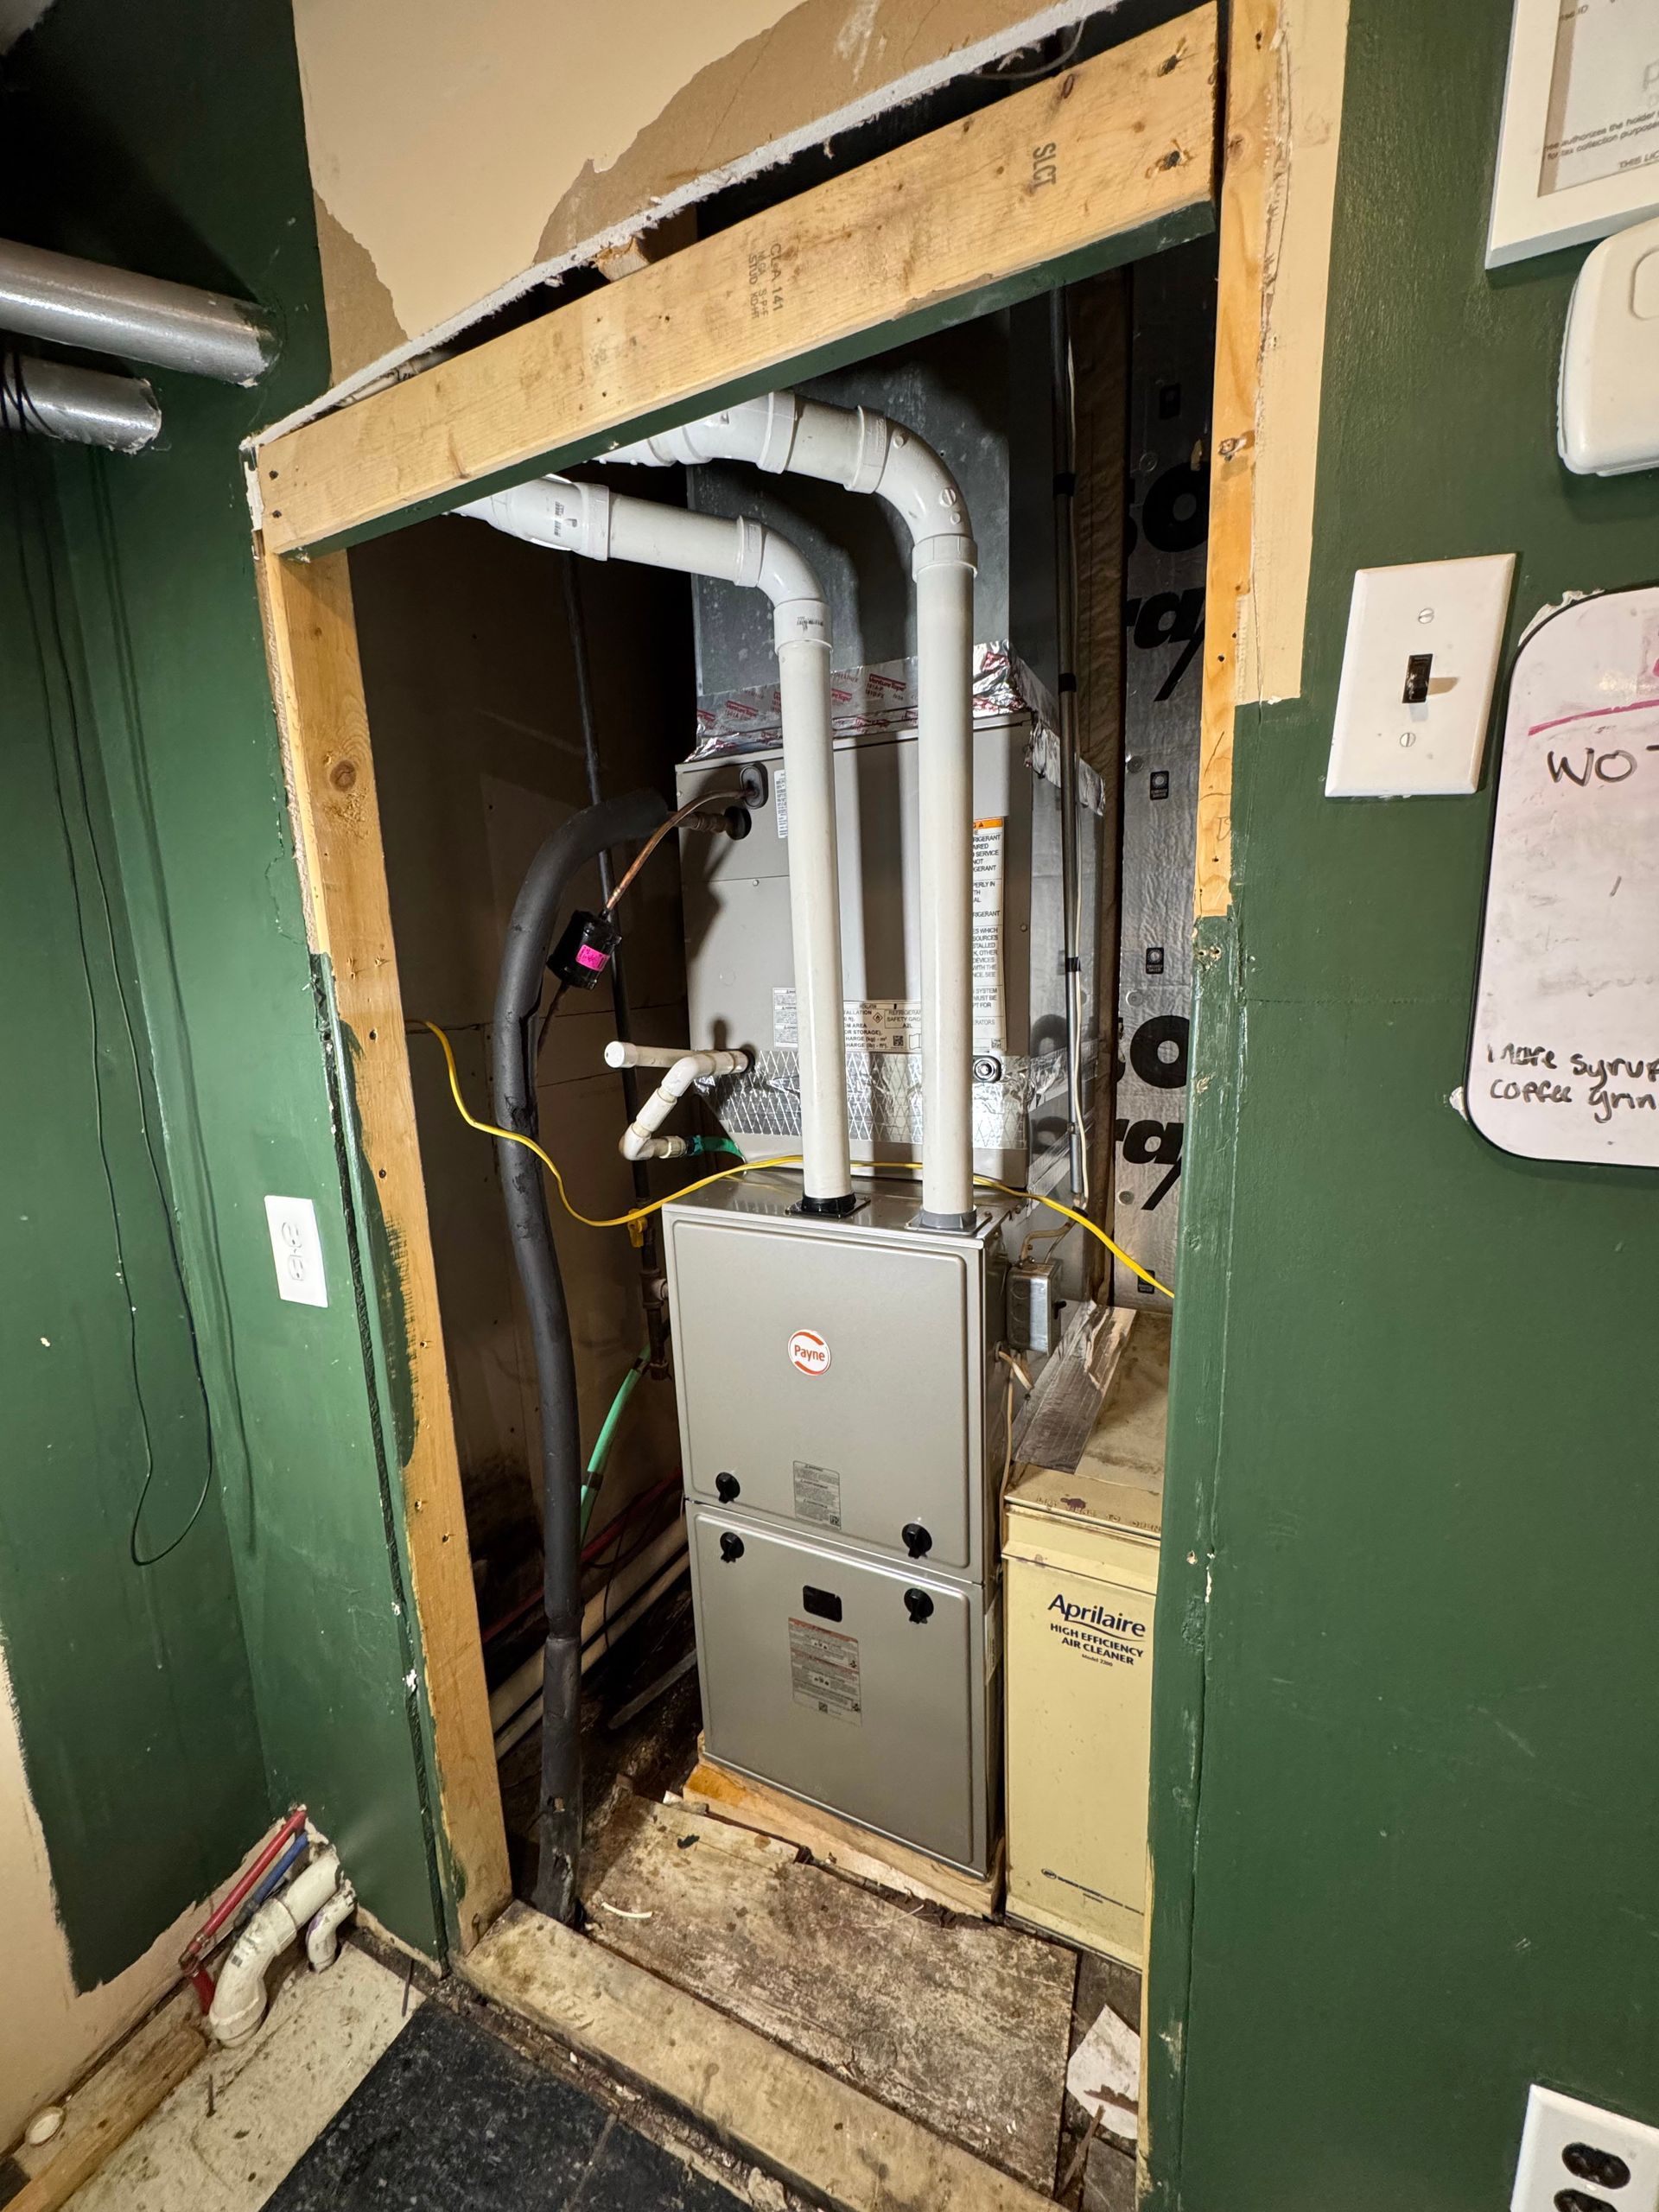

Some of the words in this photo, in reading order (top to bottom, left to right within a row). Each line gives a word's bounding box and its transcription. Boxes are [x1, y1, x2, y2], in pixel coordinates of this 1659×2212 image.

[1560, 127, 1607, 147] authorizes
[1609, 121, 1624, 132] the
[1625, 111, 1656, 125] holder
[1576, 134, 1618, 152] collection
[1033, 142, 1056, 188] SLCT
[794, 1344, 825, 1363] Payne
[1047, 1593, 1147, 1637] Aprilaire
[1050, 1623, 1079, 1638] HIGH
[1081, 1632, 1144, 1658] EFFICIENCY
[1061, 1637, 1081, 1649] AIR
[1083, 1643, 1135, 1666] CLEANER
